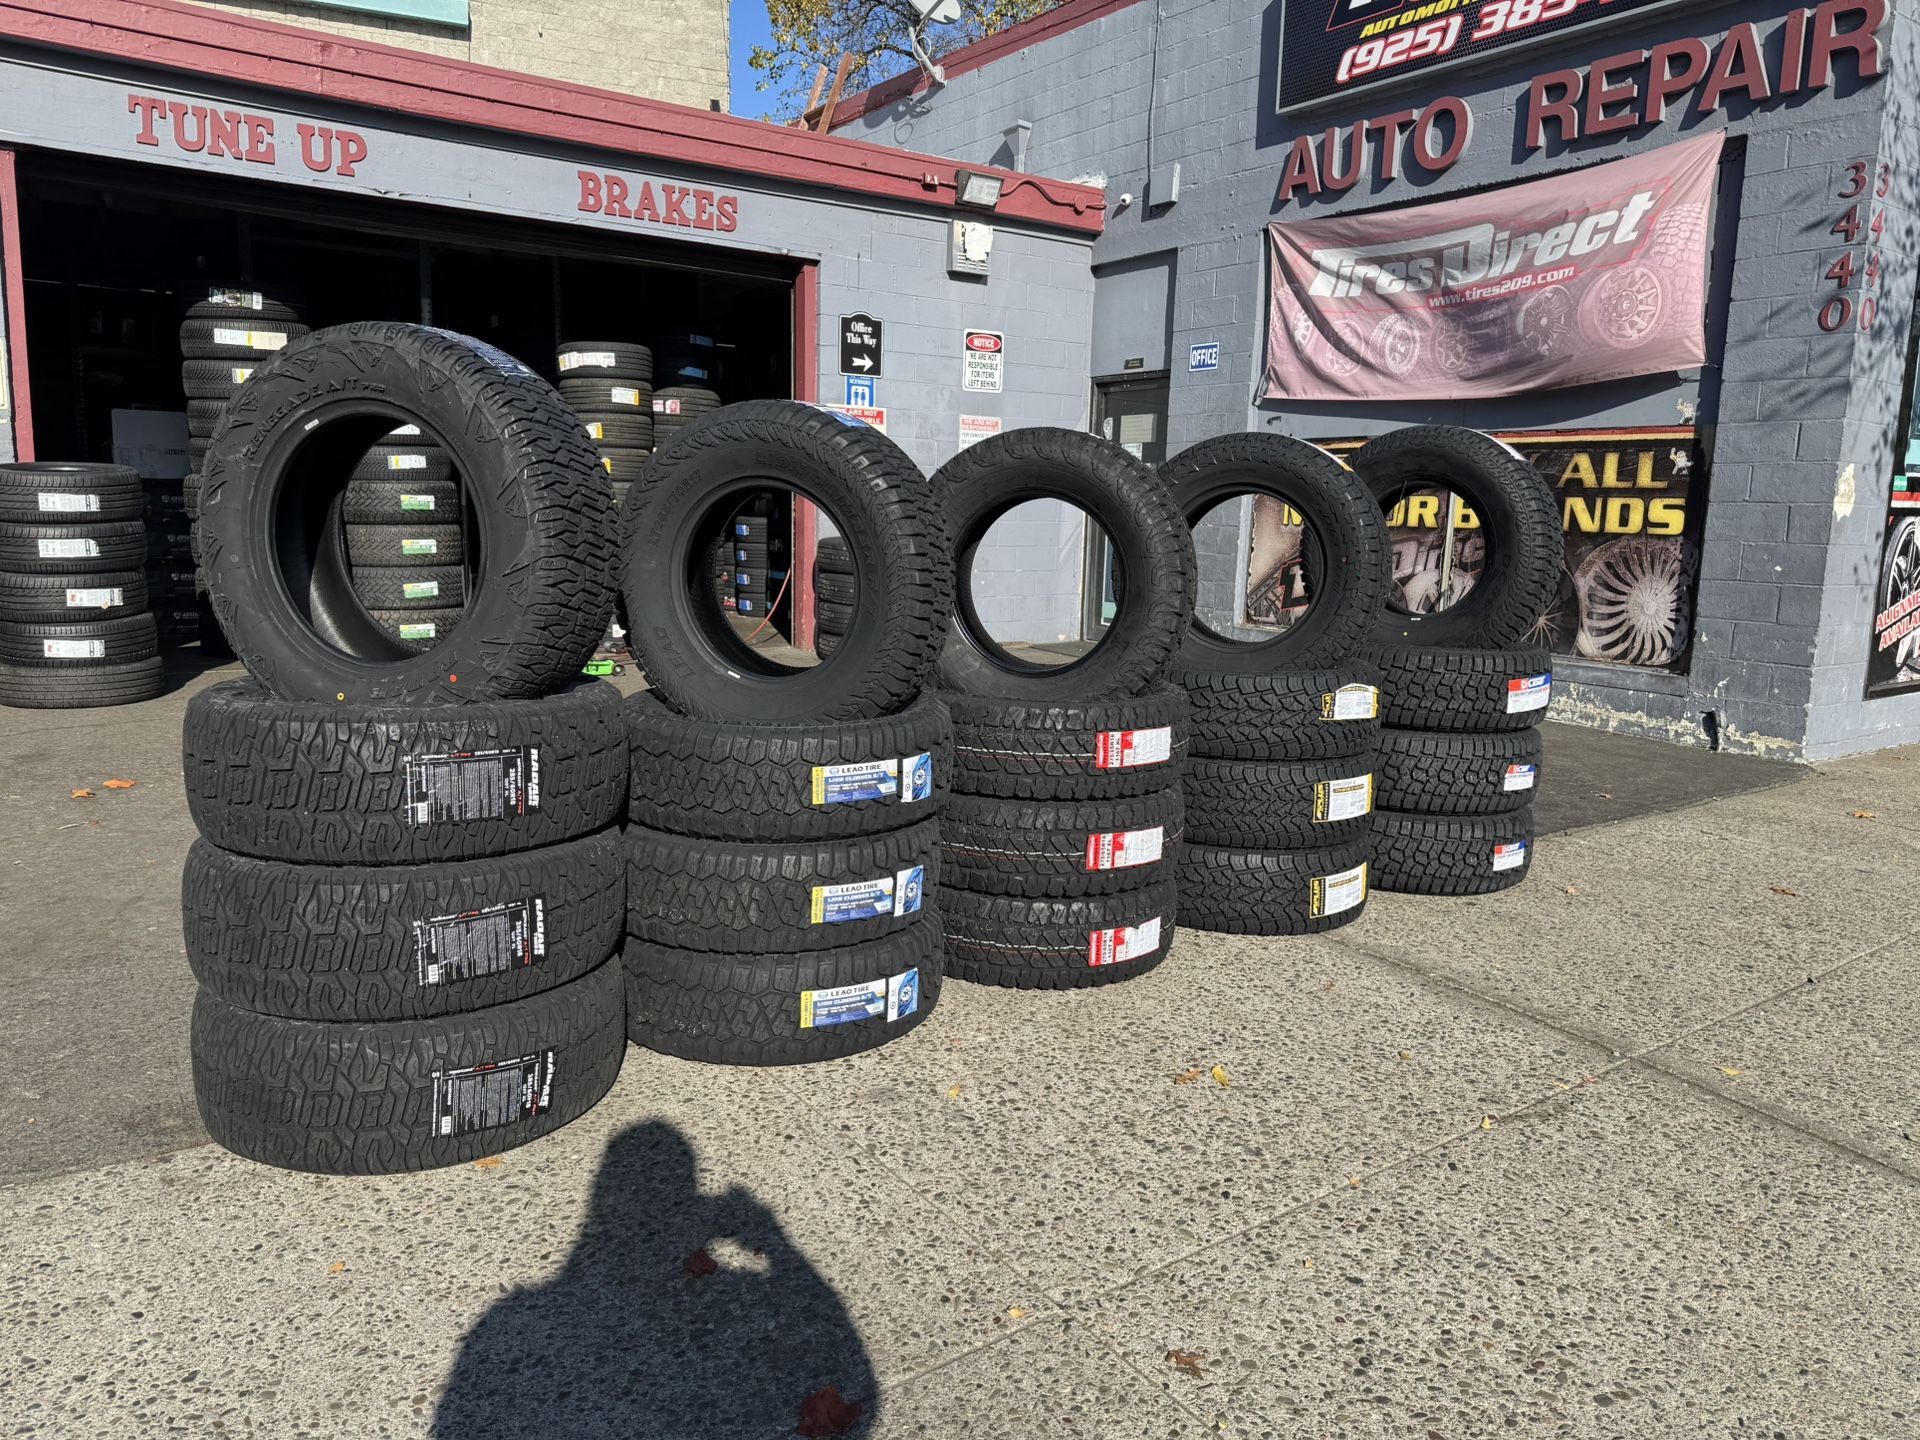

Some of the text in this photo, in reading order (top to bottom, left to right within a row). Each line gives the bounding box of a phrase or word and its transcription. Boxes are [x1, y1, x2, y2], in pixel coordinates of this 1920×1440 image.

[1336, 15, 1464, 82] (925)
[1278, 0, 1890, 200] AUTO REPAIR
[128, 94, 368, 178] TUNE UP
[577, 170, 738, 233] BRAKES
[1427, 266, 1575, 308] www.tires209.com
[851, 322, 873, 334] Office
[846, 333, 877, 348] This Way
[973, 337, 995, 349] NOTICE
[970, 352, 997, 362] WE ARE NOT
[1191, 347, 1217, 367] OFFICE
[967, 361, 999, 371] RESPONSIBLE
[971, 370, 995, 379] FOR ITEMS
[968, 379, 979, 387] LEFT
[242, 383, 324, 462] RENEGADE
[327, 377, 359, 394] A/T
[848, 409, 863, 417] ARE
[1555, 451, 1670, 489] ALL
[842, 763, 881, 774] LEAO TIRE
[530, 748, 540, 808] RADAR
[862, 883, 879, 891] TIRE
[535, 898, 544, 957] RADAR
[831, 984, 870, 997] LEAO TIRE
